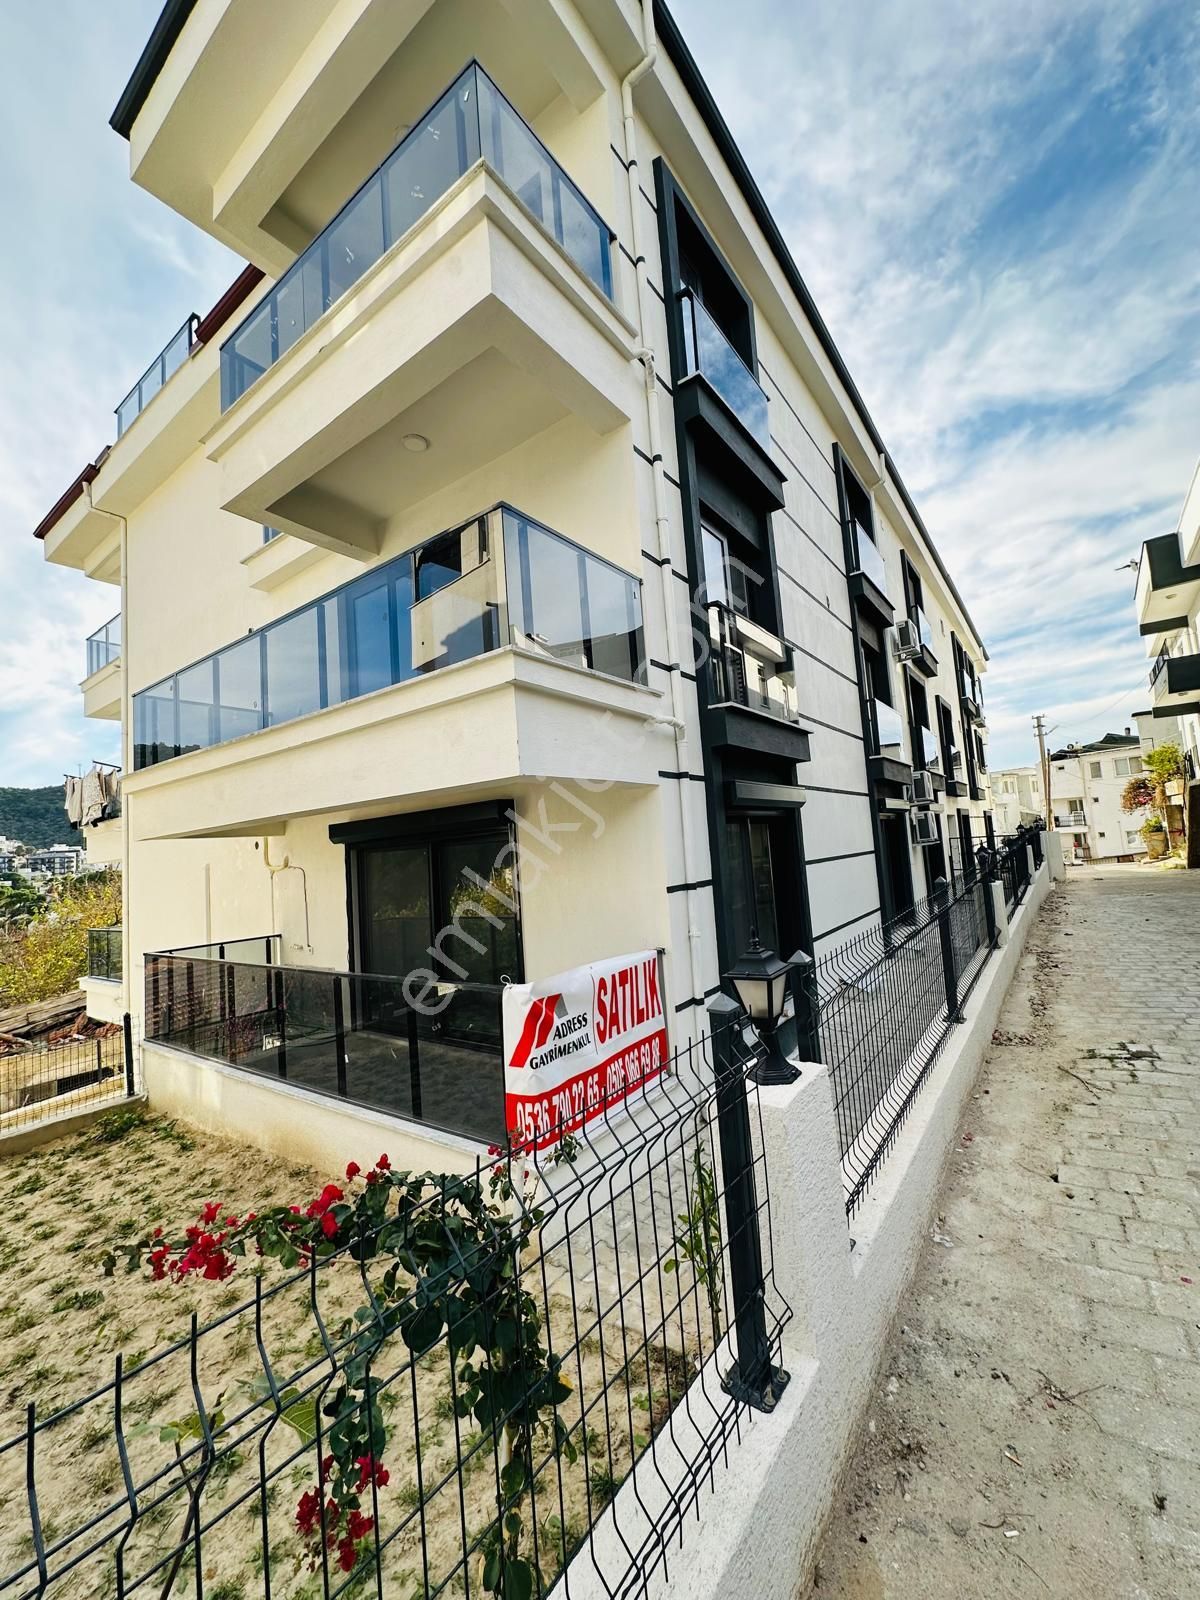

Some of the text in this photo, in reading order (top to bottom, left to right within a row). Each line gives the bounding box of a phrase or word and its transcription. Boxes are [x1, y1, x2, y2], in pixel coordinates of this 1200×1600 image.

[552, 1012, 588, 1041] ADRESS
[595, 958, 662, 1044] SATILIK
[529, 1033, 591, 1070] GAYRİMENKUL
[517, 1099, 550, 1143] 0536
[552, 1088, 573, 1134] 790
[572, 1080, 587, 1123] 22
[588, 1073, 599, 1112] 65
